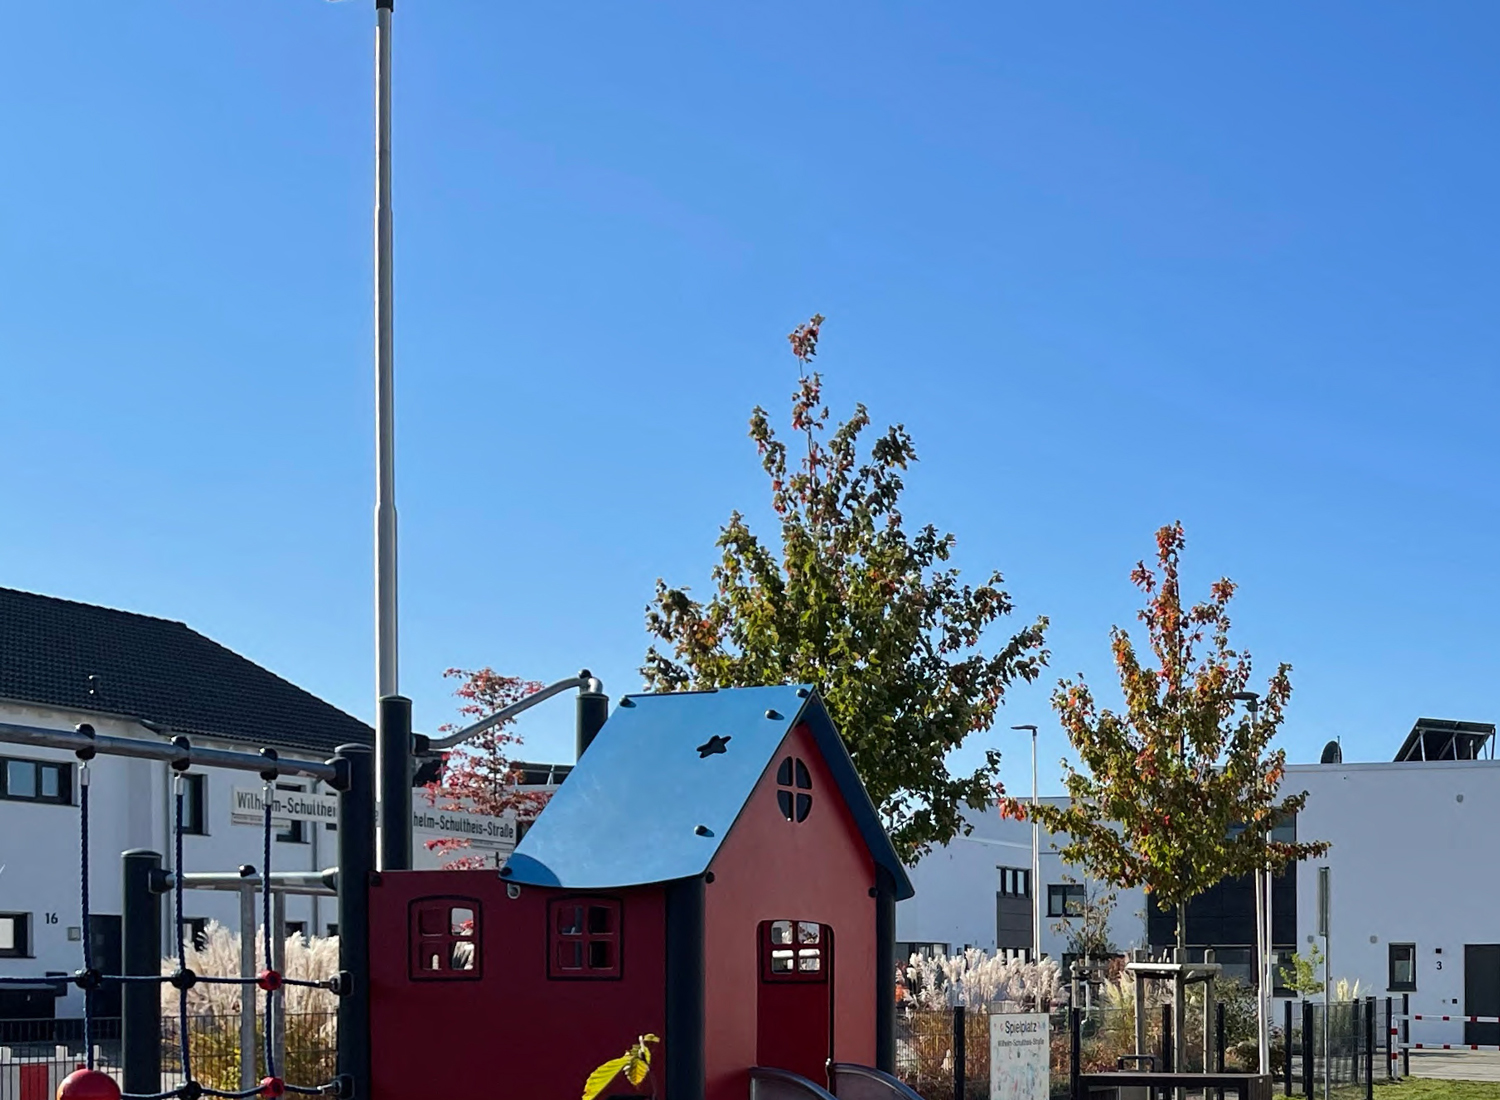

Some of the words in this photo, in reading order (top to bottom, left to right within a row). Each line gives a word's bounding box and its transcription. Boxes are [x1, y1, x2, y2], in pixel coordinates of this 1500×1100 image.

[413, 812, 514, 839] helm-Schultheis-Straße
[45, 912, 59, 924] 16
[1436, 960, 1443, 970] 3
[1004, 1020, 1037, 1036] Spielplatz
